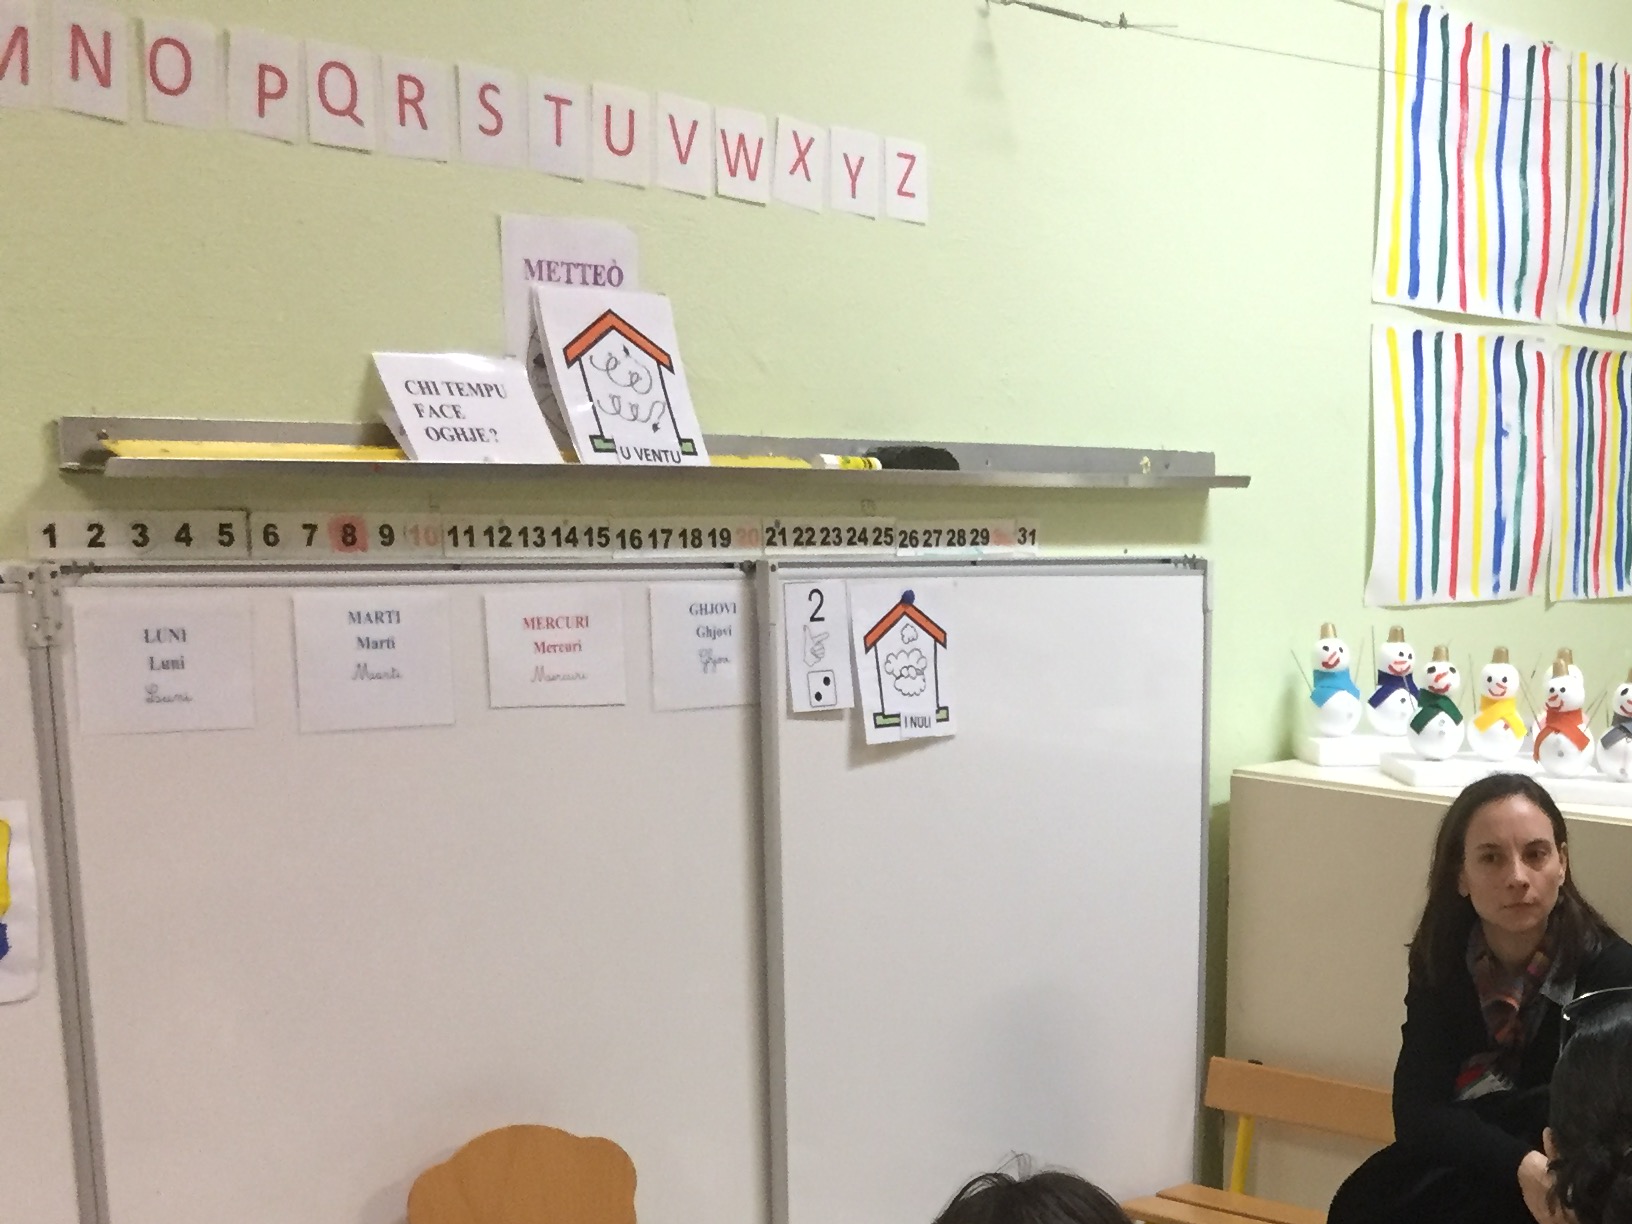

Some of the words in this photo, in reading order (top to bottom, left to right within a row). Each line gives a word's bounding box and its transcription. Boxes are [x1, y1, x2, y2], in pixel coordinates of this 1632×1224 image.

[69, 24, 112, 88] N
[148, 36, 193, 97] O
[257, 63, 289, 118] P
[317, 60, 365, 128] Q
[396, 73, 428, 130] R
[478, 82, 503, 136] S
[544, 94, 572, 146] T
[604, 104, 635, 156] U
[668, 113, 698, 165] V
[720, 128, 763, 181] W
[789, 130, 815, 182] X
[843, 152, 864, 199] Y
[896, 152, 917, 198] Z
[523, 258, 625, 288] METTEÒ
[404, 379, 440, 397] CHI
[441, 380, 508, 400] TEMPU
[414, 403, 466, 420] FACE
[425, 427, 499, 443] OGHJE?
[619, 446, 632, 461] U
[633, 446, 682, 464] VENTU
[42, 523, 56, 549] 1
[86, 522, 106, 548] 2
[131, 522, 150, 548] 3
[173, 522, 194, 548] 4
[217, 522, 236, 548] 5
[262, 522, 281, 548] 6
[301, 522, 319, 548] 7
[341, 522, 358, 548] 8
[378, 522, 395, 548] 9
[447, 525, 475, 548] 11
[483, 525, 513, 548] 12
[517, 525, 546, 548] 13
[551, 525, 579, 548] 14
[583, 525, 611, 548] 15
[615, 528, 643, 550] 16
[647, 528, 673, 549] 17
[678, 527, 703, 549] 18
[707, 527, 732, 549] 19
[765, 526, 787, 547] 21
[792, 526, 817, 547] 22
[819, 526, 843, 547] 23
[846, 526, 869, 547] 24
[872, 526, 894, 546] 25
[898, 529, 920, 548] 26
[922, 529, 943, 547] 27
[946, 528, 967, 547] 28
[969, 528, 990, 546] 29
[1017, 527, 1037, 546] 31
[689, 602, 737, 616] GHJOVI
[808, 588, 825, 622] 2
[348, 610, 401, 625] MARTI
[523, 615, 590, 631] MERCURI
[143, 628, 187, 644] LUNI
[356, 636, 396, 650] Marti
[149, 656, 185, 671] Luni
